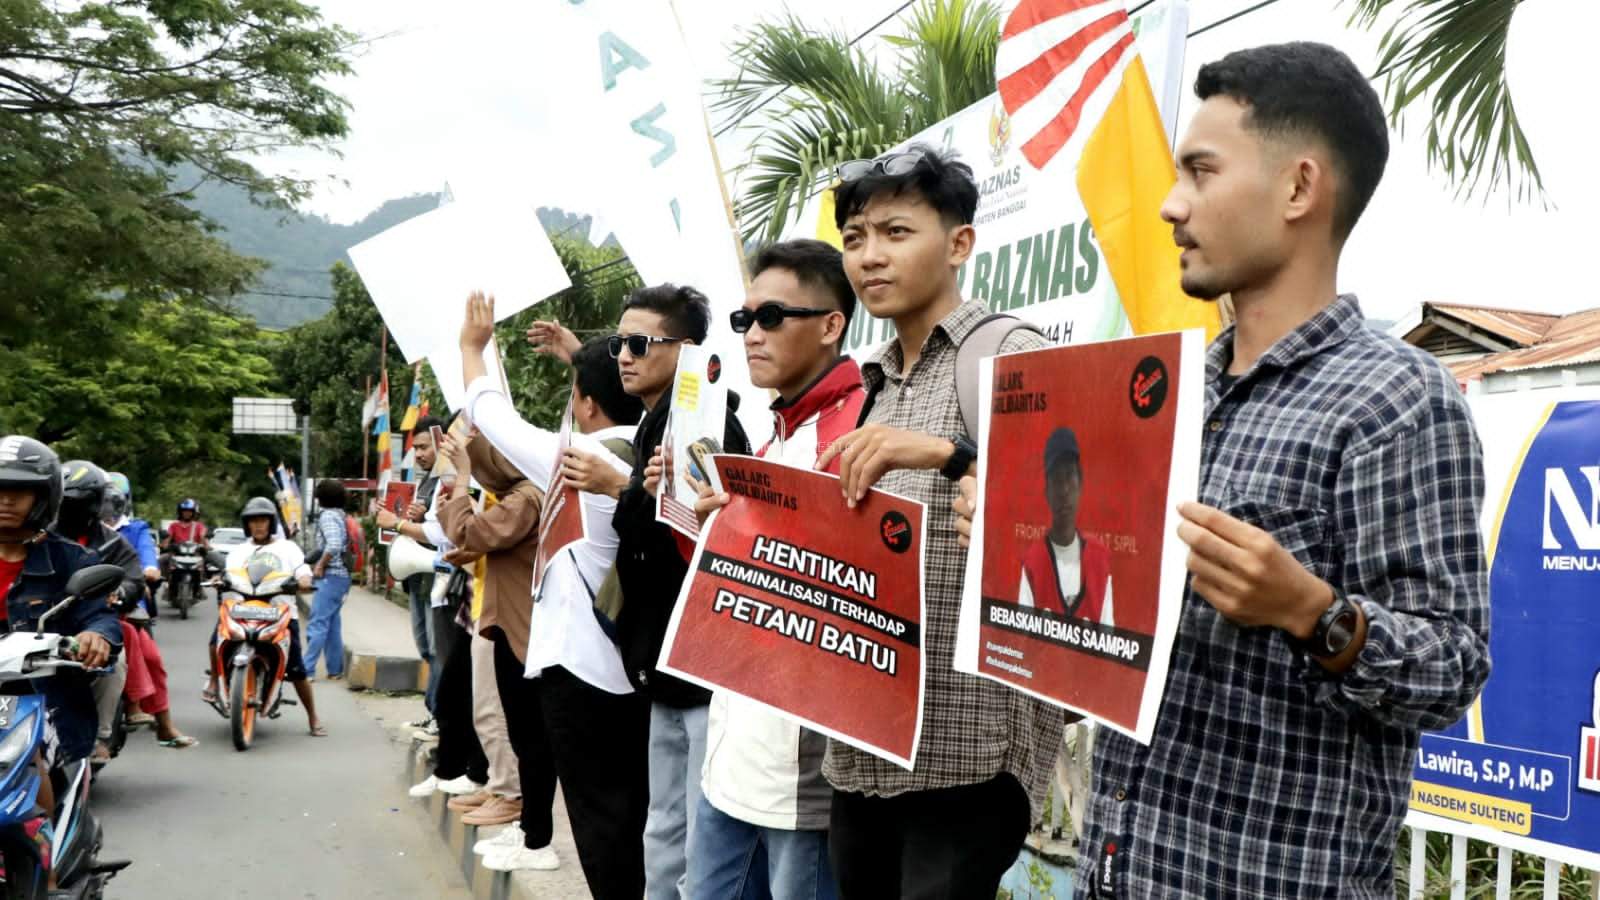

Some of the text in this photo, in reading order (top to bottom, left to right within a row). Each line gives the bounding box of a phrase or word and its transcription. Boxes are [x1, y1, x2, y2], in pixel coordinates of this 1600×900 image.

[970, 217, 1099, 314] BAZNAS
[752, 536, 876, 599] HENTIKAN
[1542, 555, 1600, 571] MENU
[709, 558, 906, 637] KRIMINALISASI TERHADAP
[713, 589, 898, 676] PETANI BATUI
[989, 605, 1140, 661] BEBASKAN DEMAS SAAMPAP
[1418, 747, 1554, 792] Lawira, S.P, M.P
[1417, 790, 1467, 813] NASDEM
[1469, 802, 1526, 826] SULTENG
